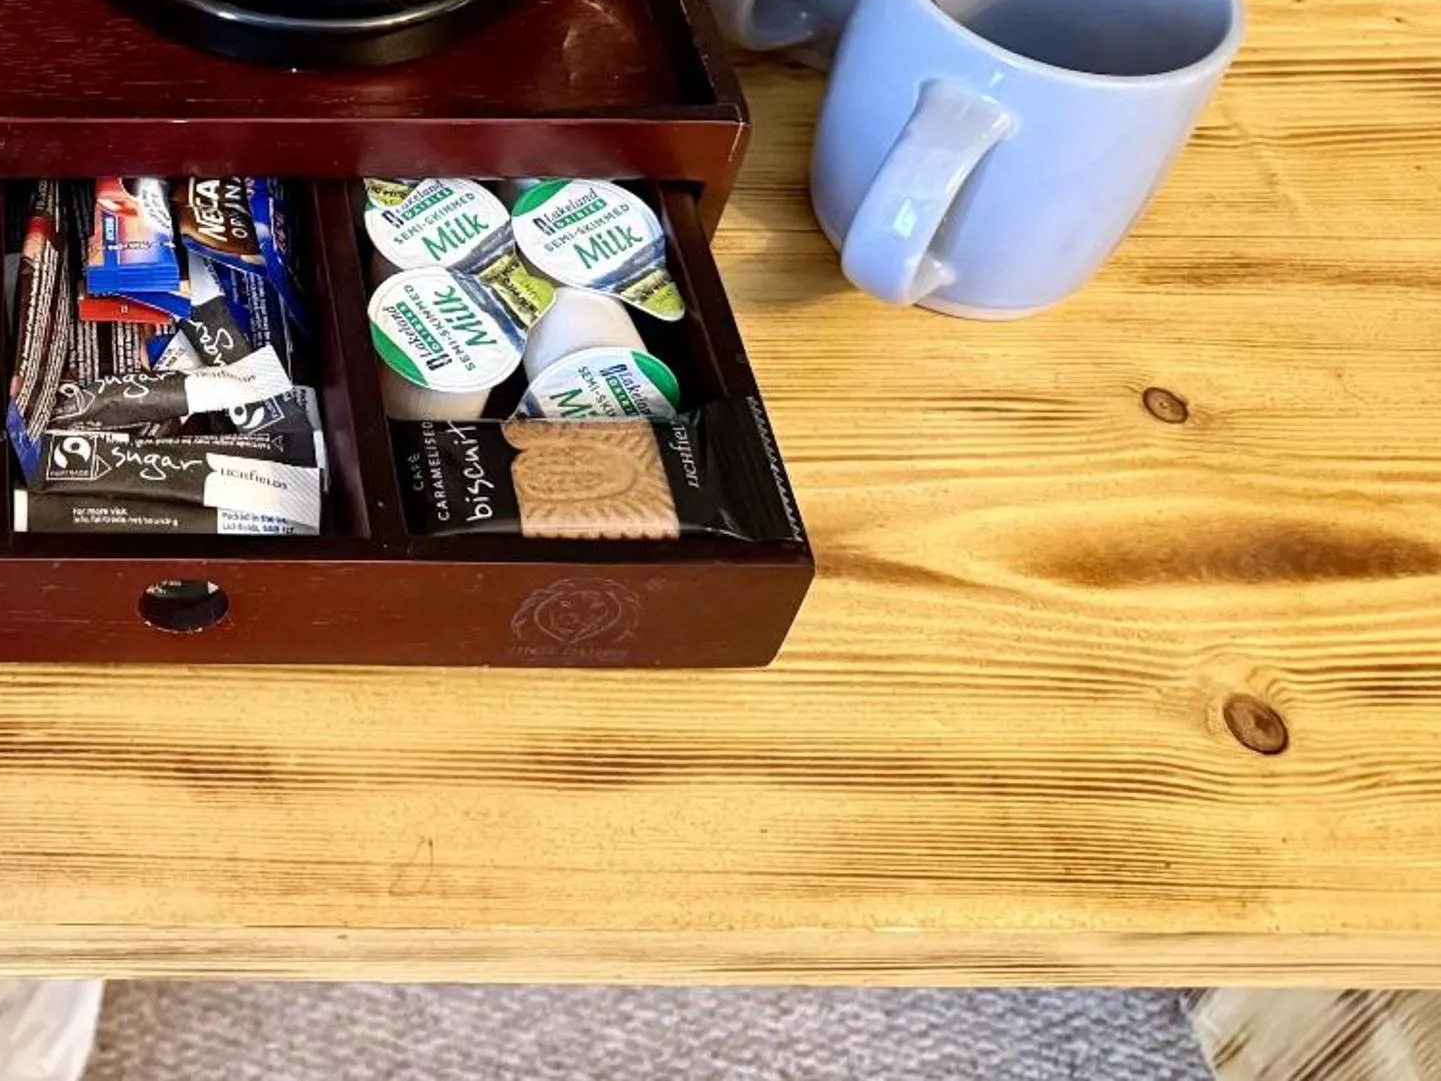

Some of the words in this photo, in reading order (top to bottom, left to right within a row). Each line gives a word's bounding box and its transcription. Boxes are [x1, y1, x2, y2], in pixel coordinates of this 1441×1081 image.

[394, 192, 476, 245] SEMI-SKIMMED
[544, 187, 599, 221] Lakeland
[544, 203, 630, 252] SEMI-SKIMMED
[421, 213, 489, 261] Milk
[572, 225, 643, 269] Milk
[382, 305, 433, 358] Lakeland
[403, 284, 476, 371] SEMI-SKIMMED
[433, 285, 498, 347] Milk
[182, 320, 234, 366] ugar
[620, 372, 654, 416] Lakelan
[422, 421, 451, 521] CARAMELISED
[445, 420, 495, 522] biscuit
